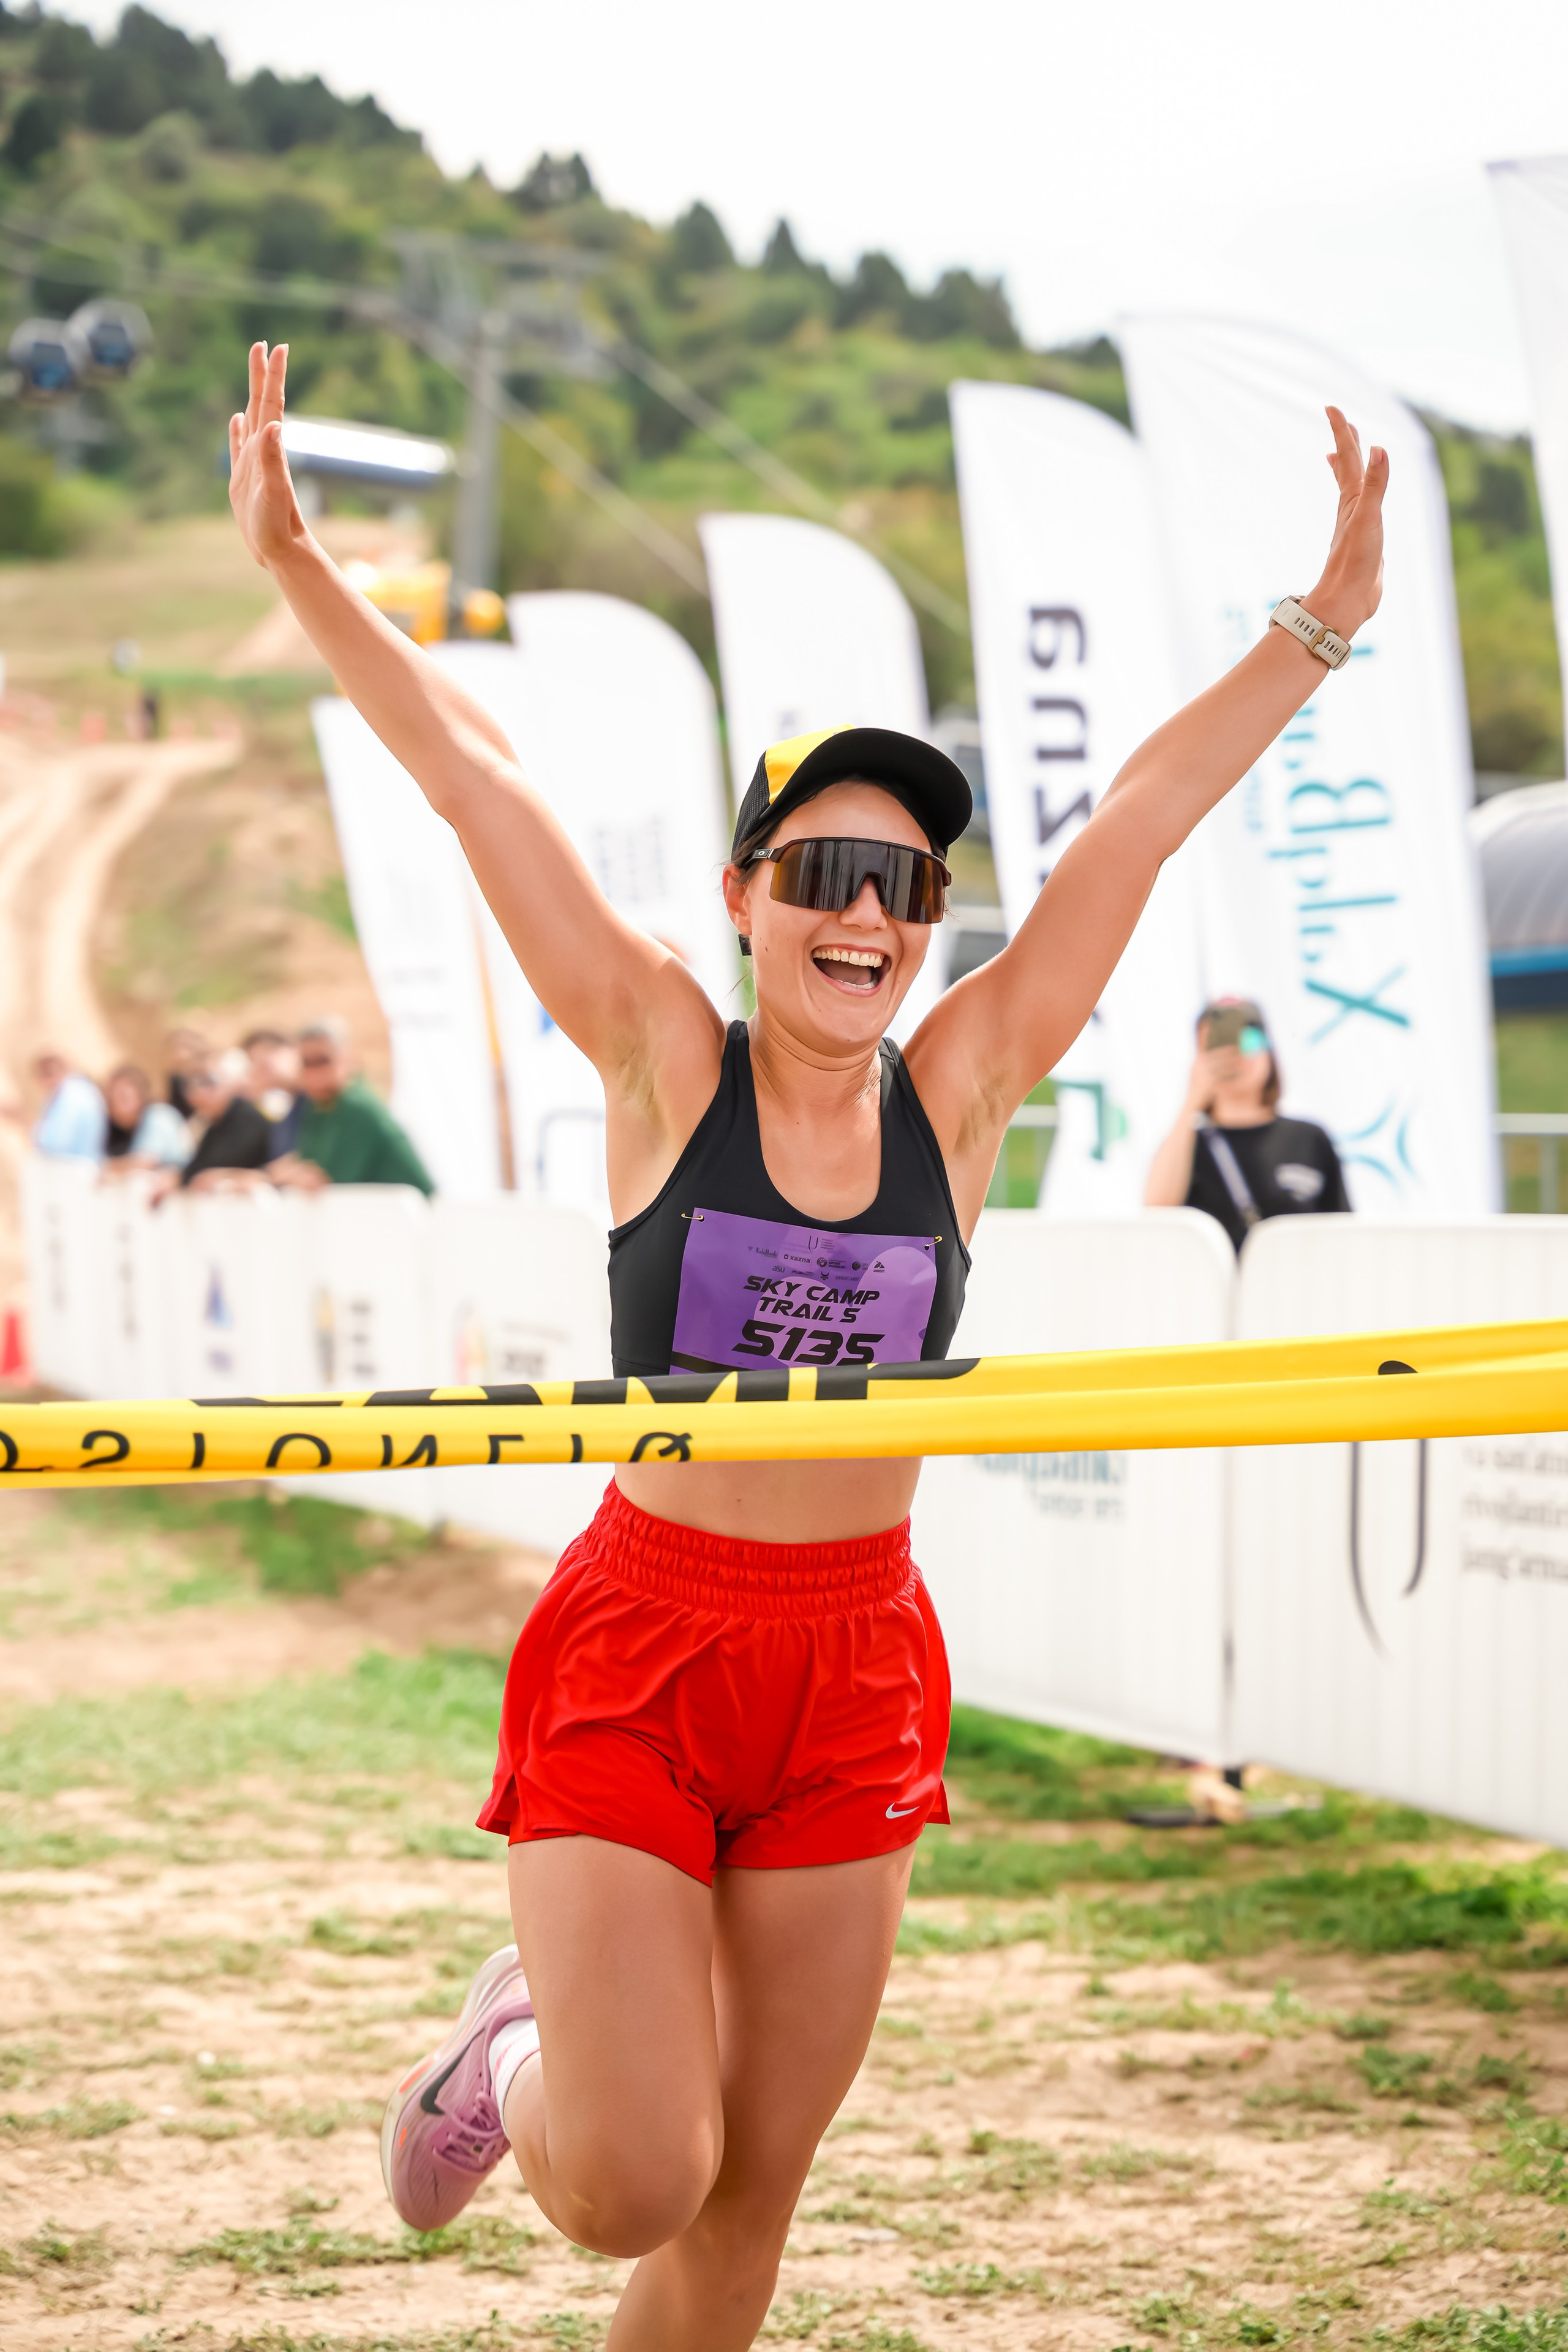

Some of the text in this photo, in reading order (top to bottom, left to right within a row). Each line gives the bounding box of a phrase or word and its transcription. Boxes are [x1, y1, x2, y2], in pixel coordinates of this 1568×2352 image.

[743, 1275, 880, 1305] SKY CAMP
[759, 1296, 834, 1321] TRAIL
[731, 1319, 886, 1366] 5135
